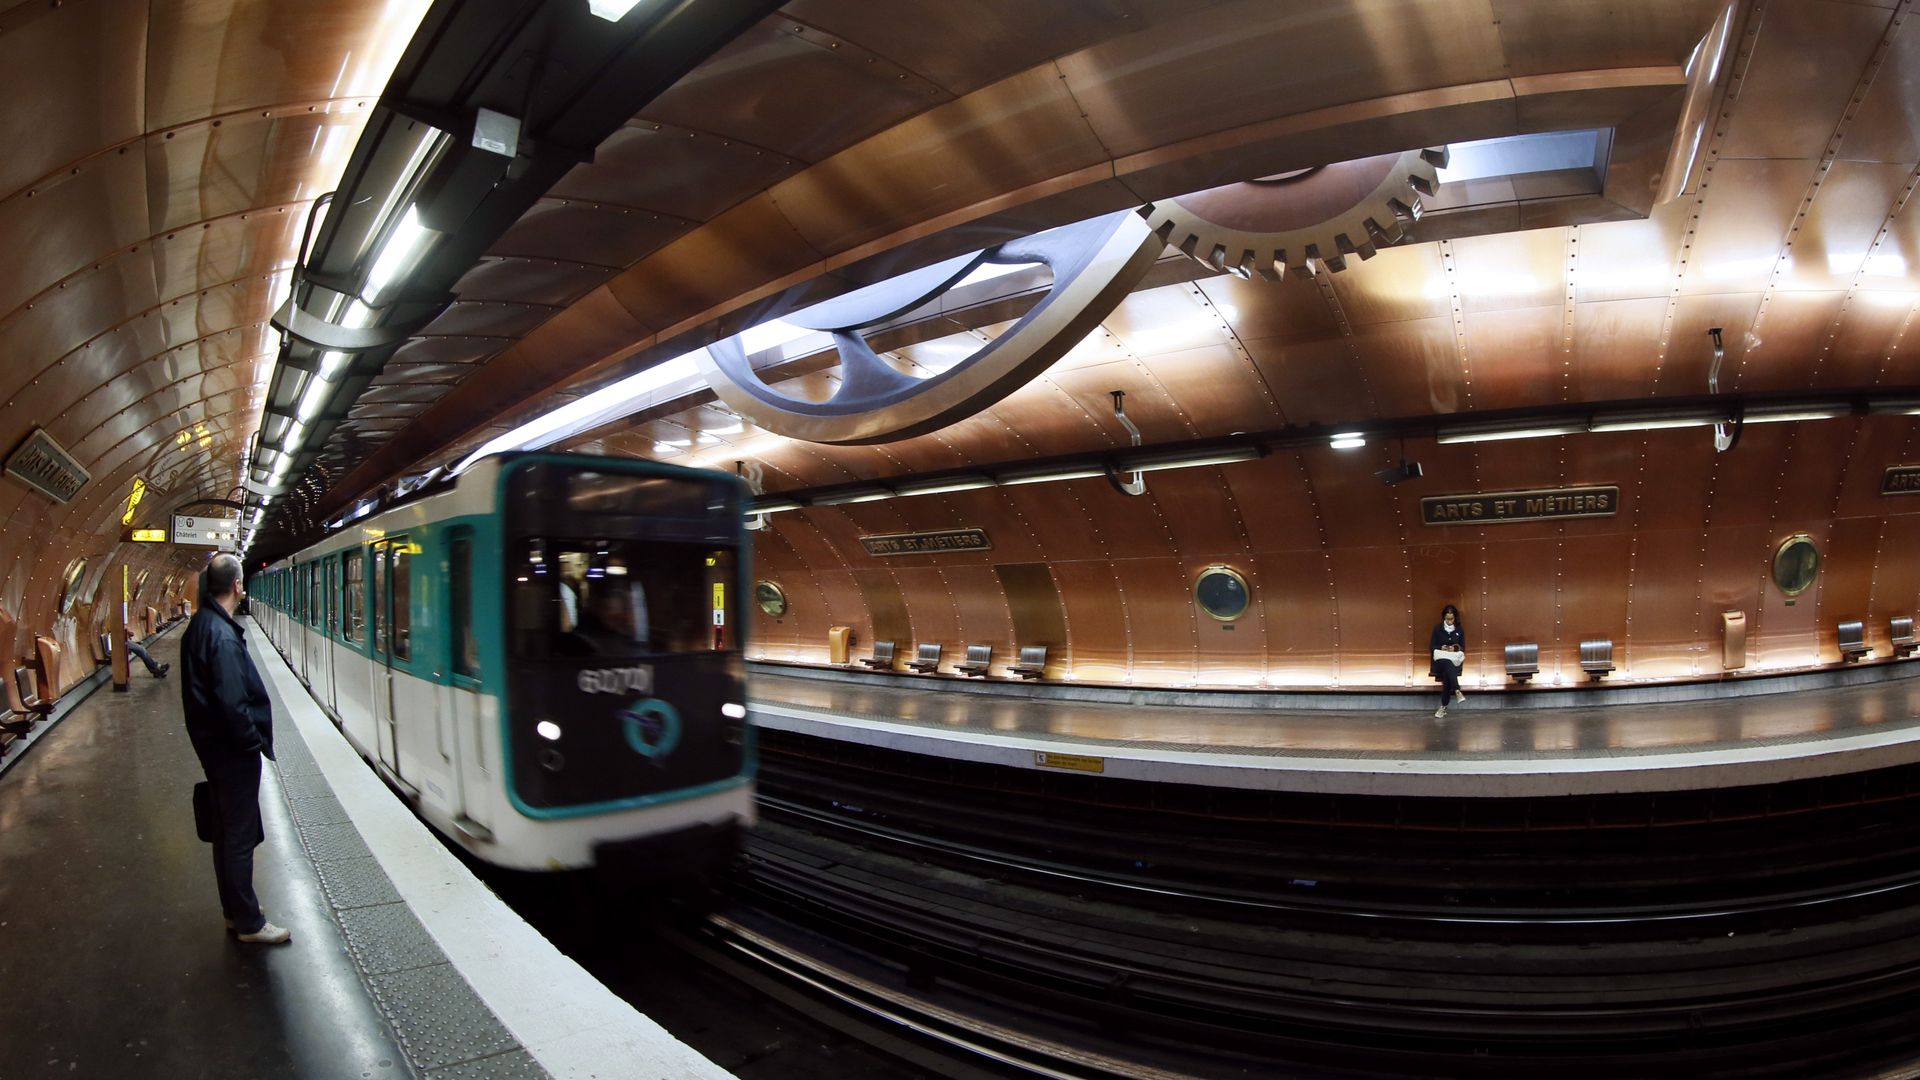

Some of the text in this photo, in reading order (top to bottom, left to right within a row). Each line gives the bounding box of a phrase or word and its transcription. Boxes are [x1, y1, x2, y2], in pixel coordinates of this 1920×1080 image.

[1433, 494, 1609, 518] ARTS ET MÉTIERS
[176, 531, 197, 539] Châtelet
[870, 535, 981, 552] ARTS ET MÉTIERS
